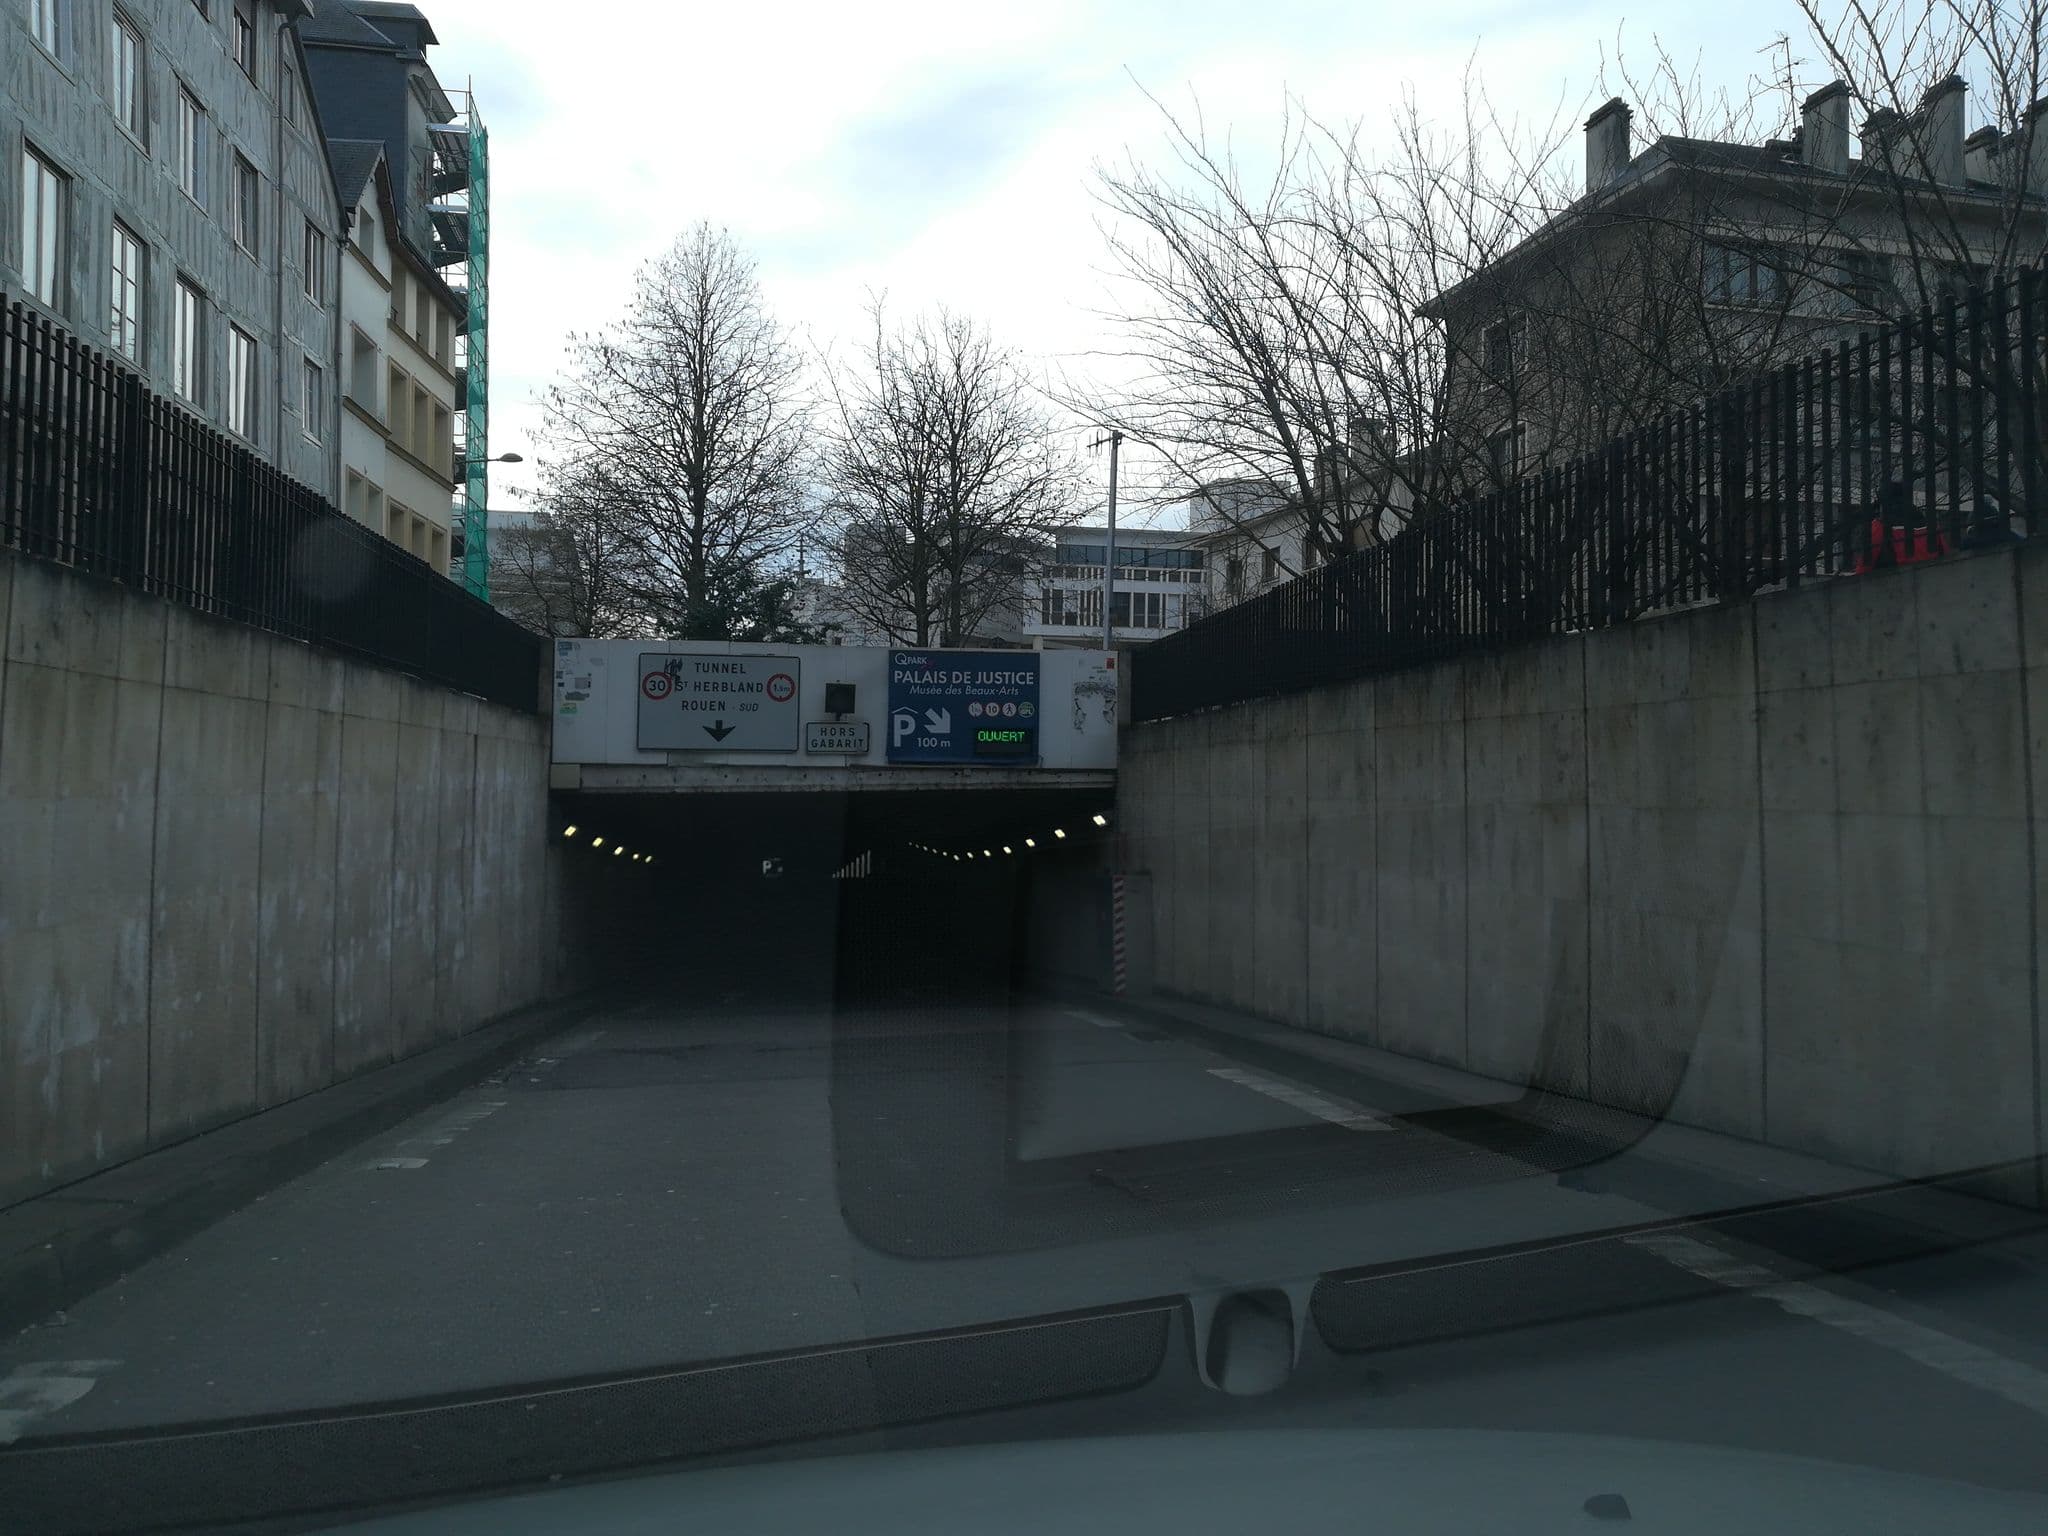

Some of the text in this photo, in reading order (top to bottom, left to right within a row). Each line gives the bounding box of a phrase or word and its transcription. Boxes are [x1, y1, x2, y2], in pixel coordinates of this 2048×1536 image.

[694, 662, 746, 674] TUNNEL
[894, 670, 1034, 685] PALAIS DE JUSTICE
[649, 680, 666, 691] 30
[693, 681, 764, 693] HERBLAND
[909, 684, 941, 695] Musée
[944, 684, 962, 695] des
[682, 700, 759, 712] ROUEN SUD
[820, 727, 855, 736] HORS
[894, 714, 916, 747] P
[977, 730, 1025, 742] OUVERT
[811, 739, 864, 748] GABARIT
[917, 737, 938, 747] 100
